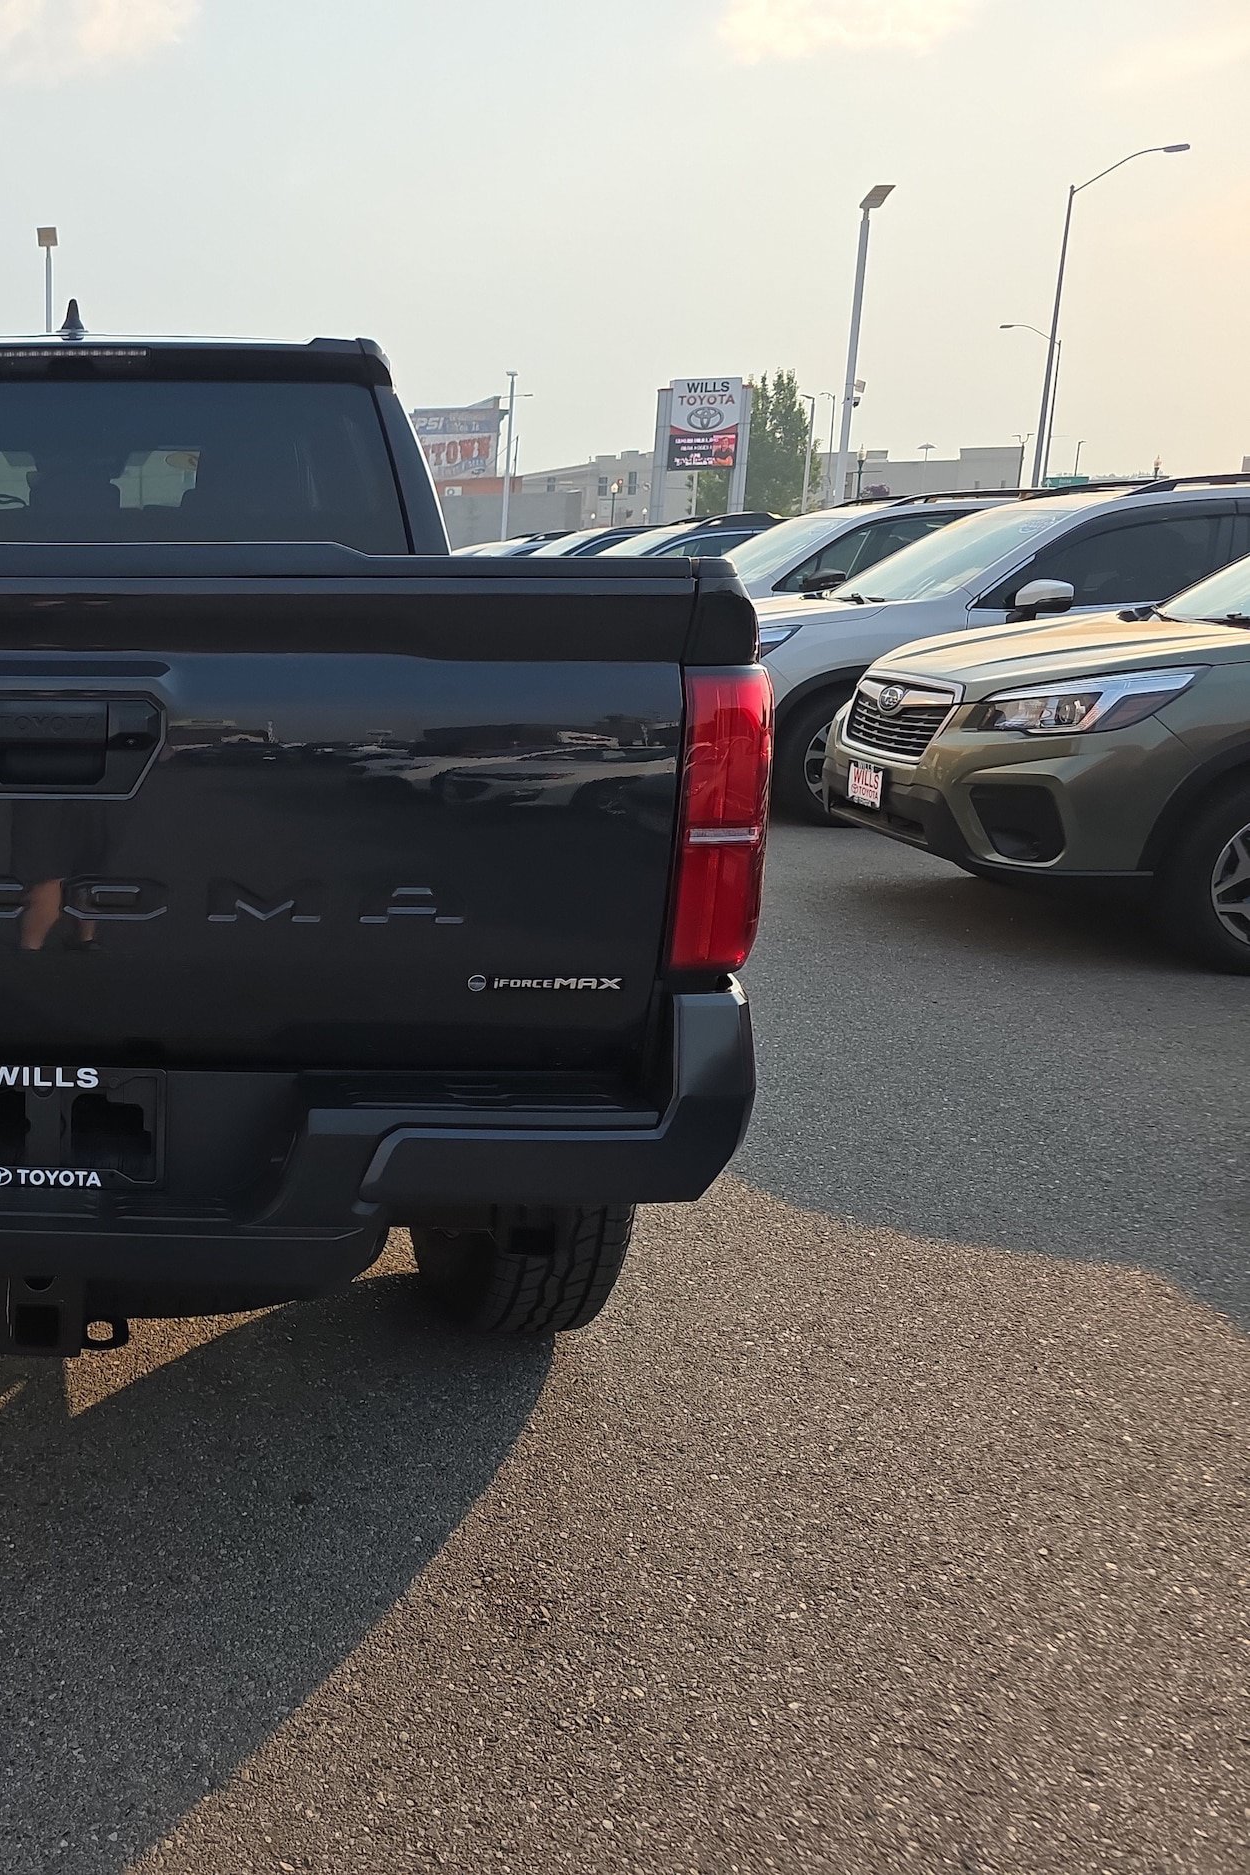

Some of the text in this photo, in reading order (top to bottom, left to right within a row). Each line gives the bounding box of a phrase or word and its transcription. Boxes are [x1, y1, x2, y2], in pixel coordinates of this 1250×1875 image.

[686, 381, 730, 393] WILLS
[678, 394, 735, 406] TOYOTA
[412, 416, 445, 431] PSI
[854, 767, 880, 790] WILLS
[859, 786, 879, 800] TOYOTA
[16, 1168, 102, 1187] TOYOTA
